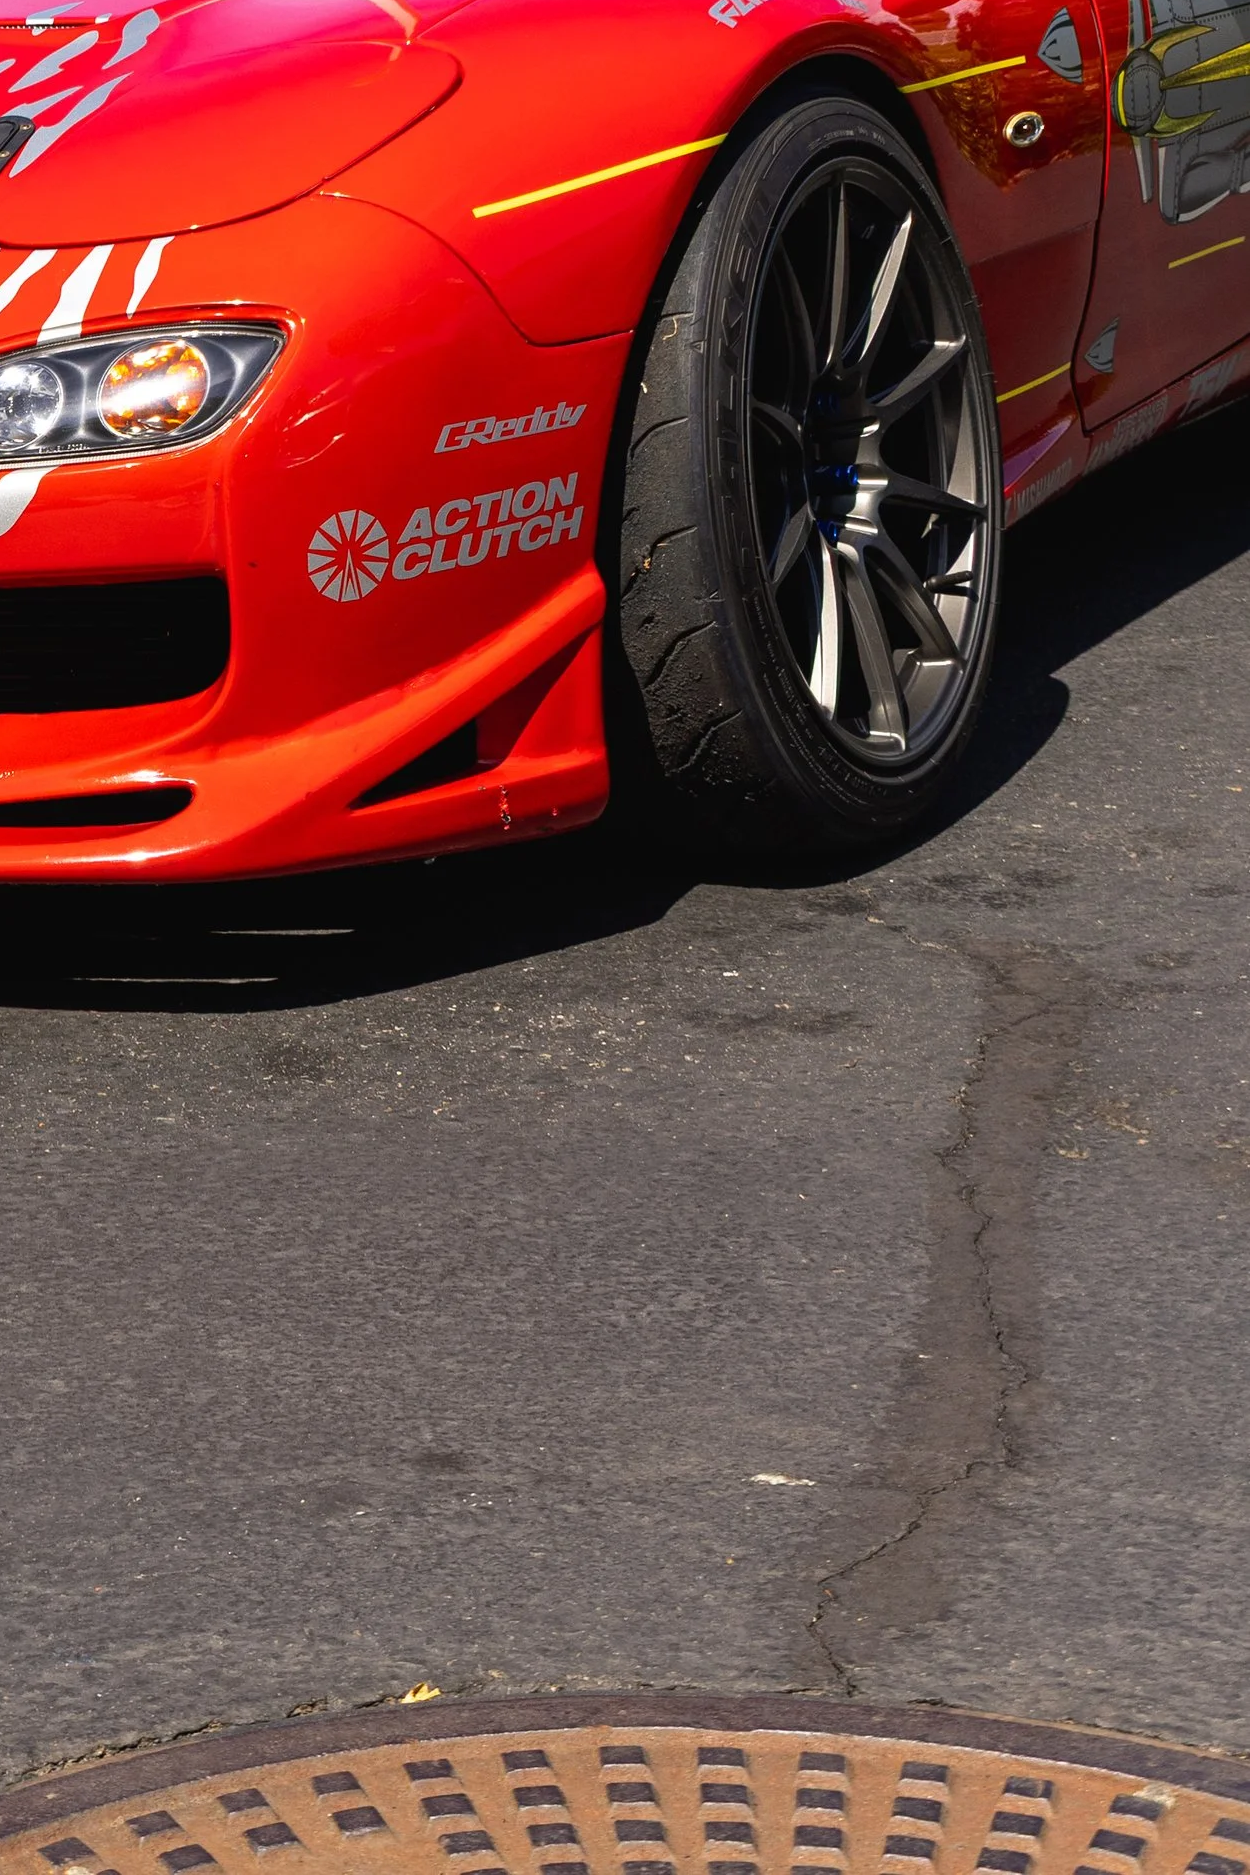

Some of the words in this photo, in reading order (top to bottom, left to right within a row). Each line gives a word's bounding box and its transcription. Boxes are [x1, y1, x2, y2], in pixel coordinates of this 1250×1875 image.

[433, 400, 588, 454] GReddy
[392, 505, 585, 581] CLUTCH
[397, 472, 579, 545] ACTION
